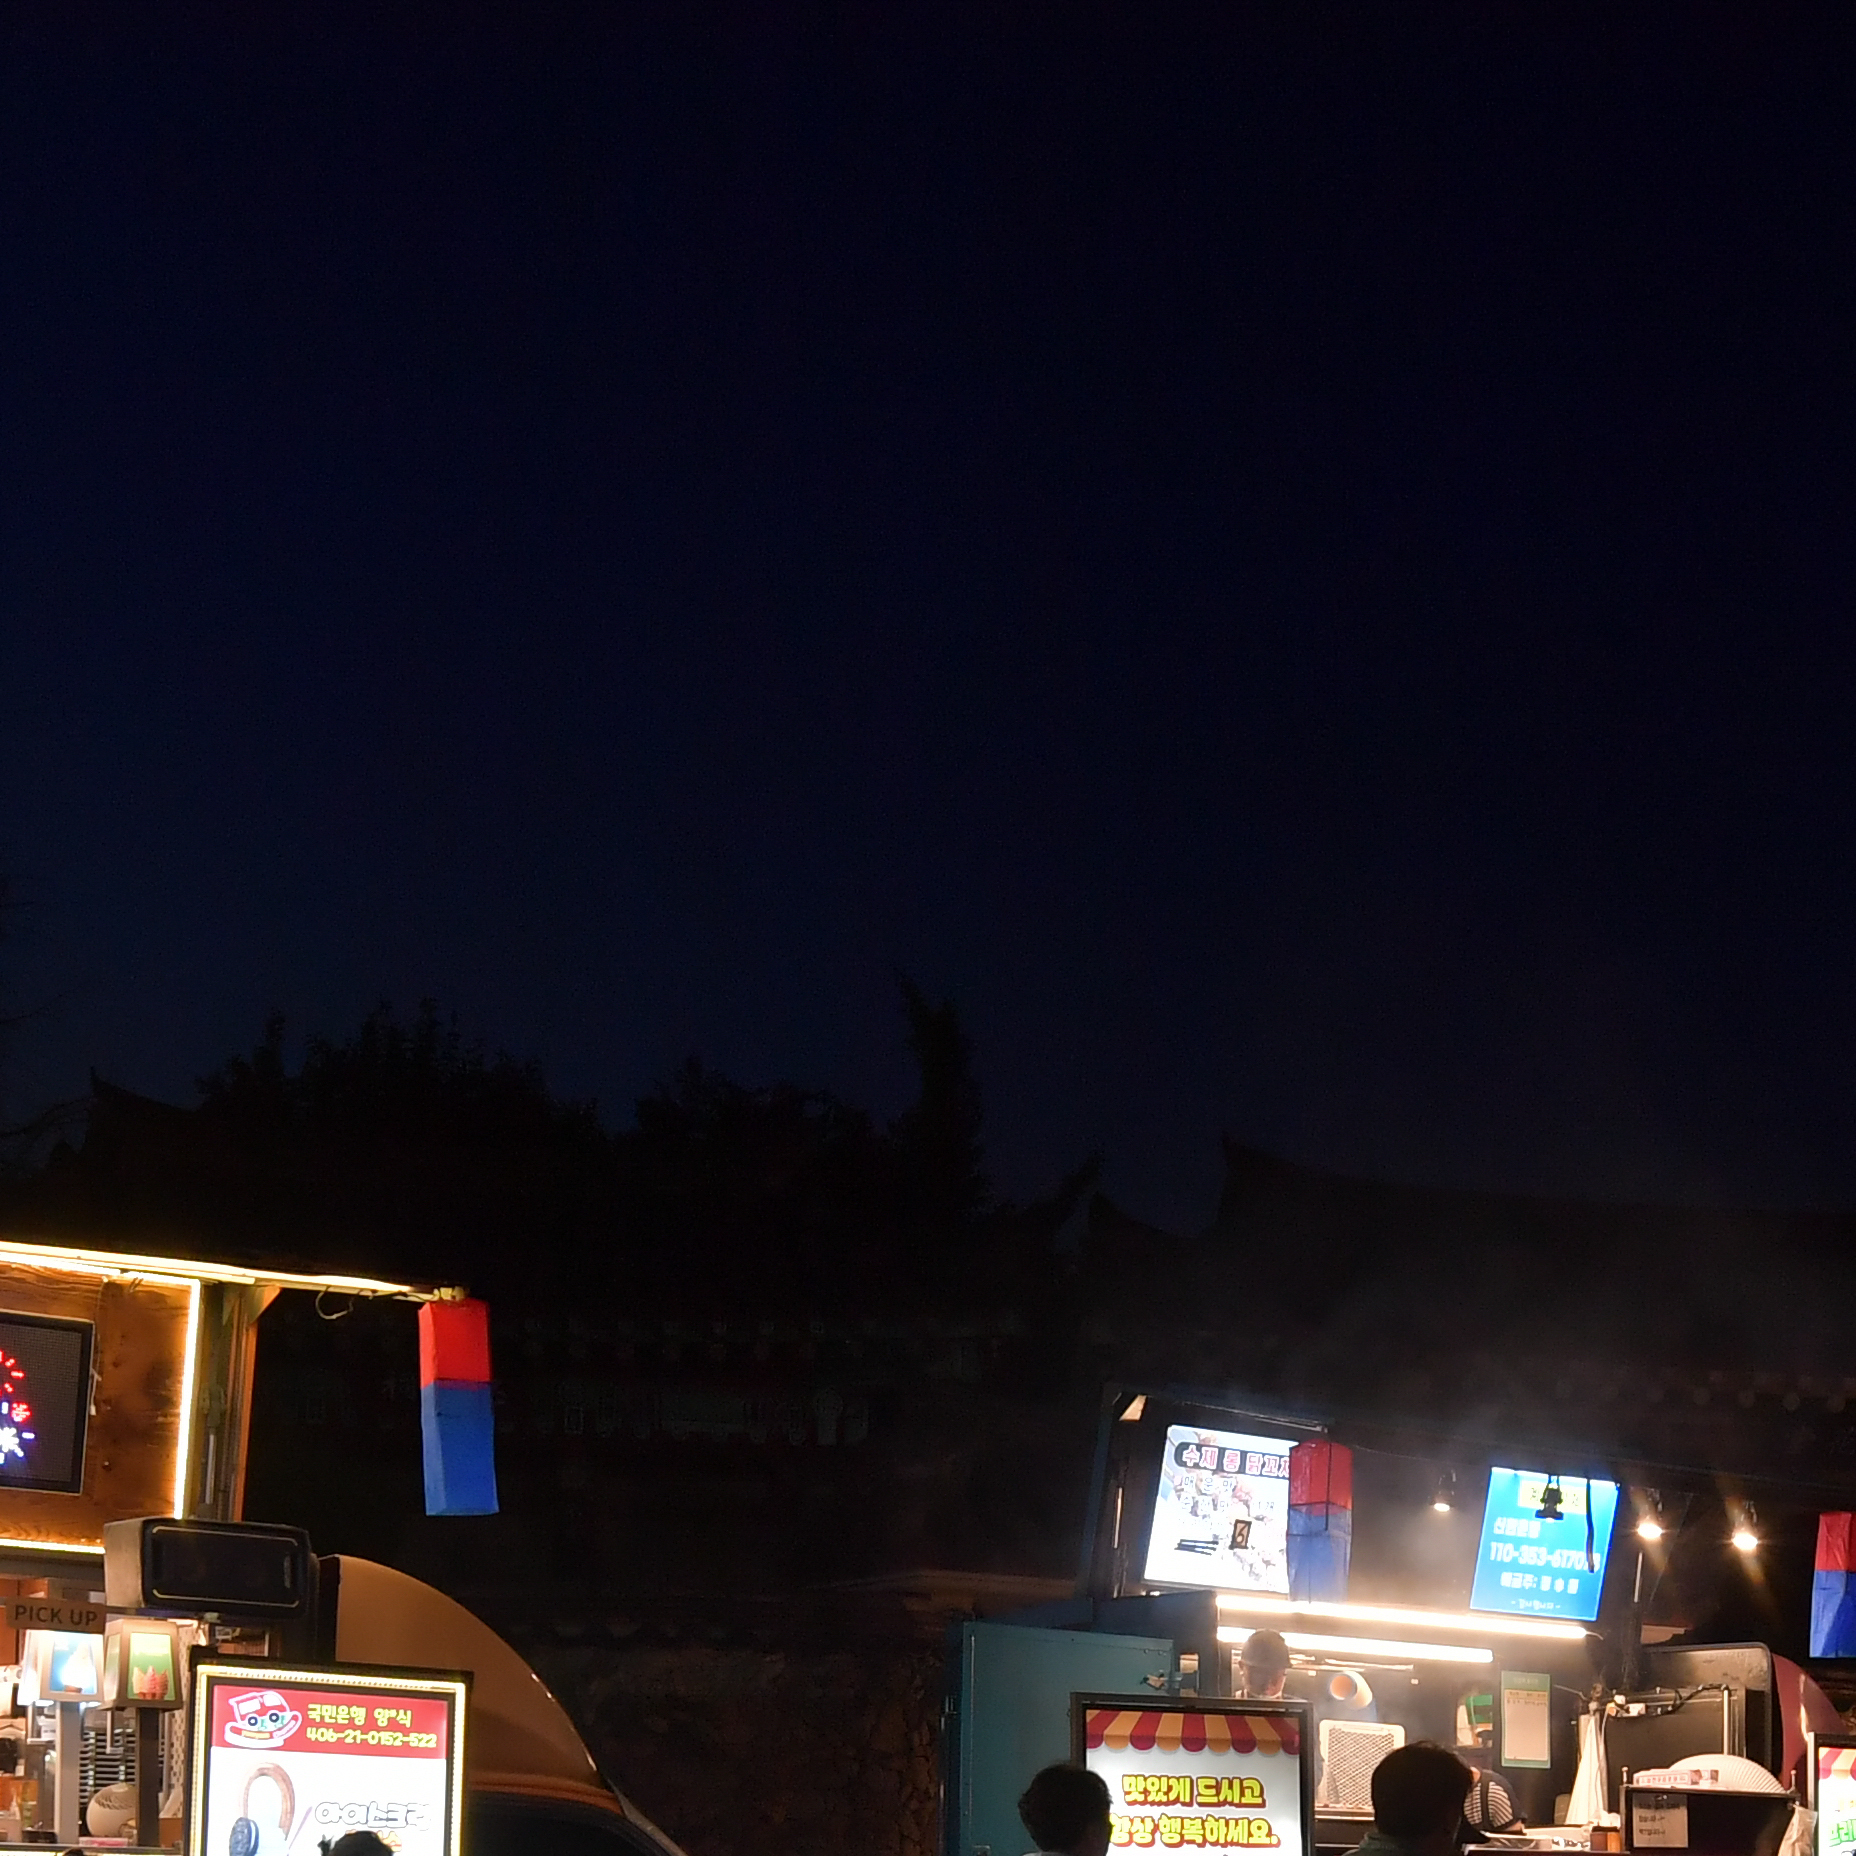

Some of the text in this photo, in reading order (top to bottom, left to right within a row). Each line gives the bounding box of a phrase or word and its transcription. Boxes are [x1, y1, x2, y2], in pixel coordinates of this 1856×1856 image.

[1490, 1542, 1600, 1572] 110-353-61708
[13, 1604, 99, 1627] PICK UP
[307, 1703, 366, 1726] 국민은행
[306, 1727, 438, 1749] 406-21-0152-522
[1122, 1774, 1267, 1809] 맛있게 드시고
[1157, 1812, 1281, 1848] 행복하세요.
